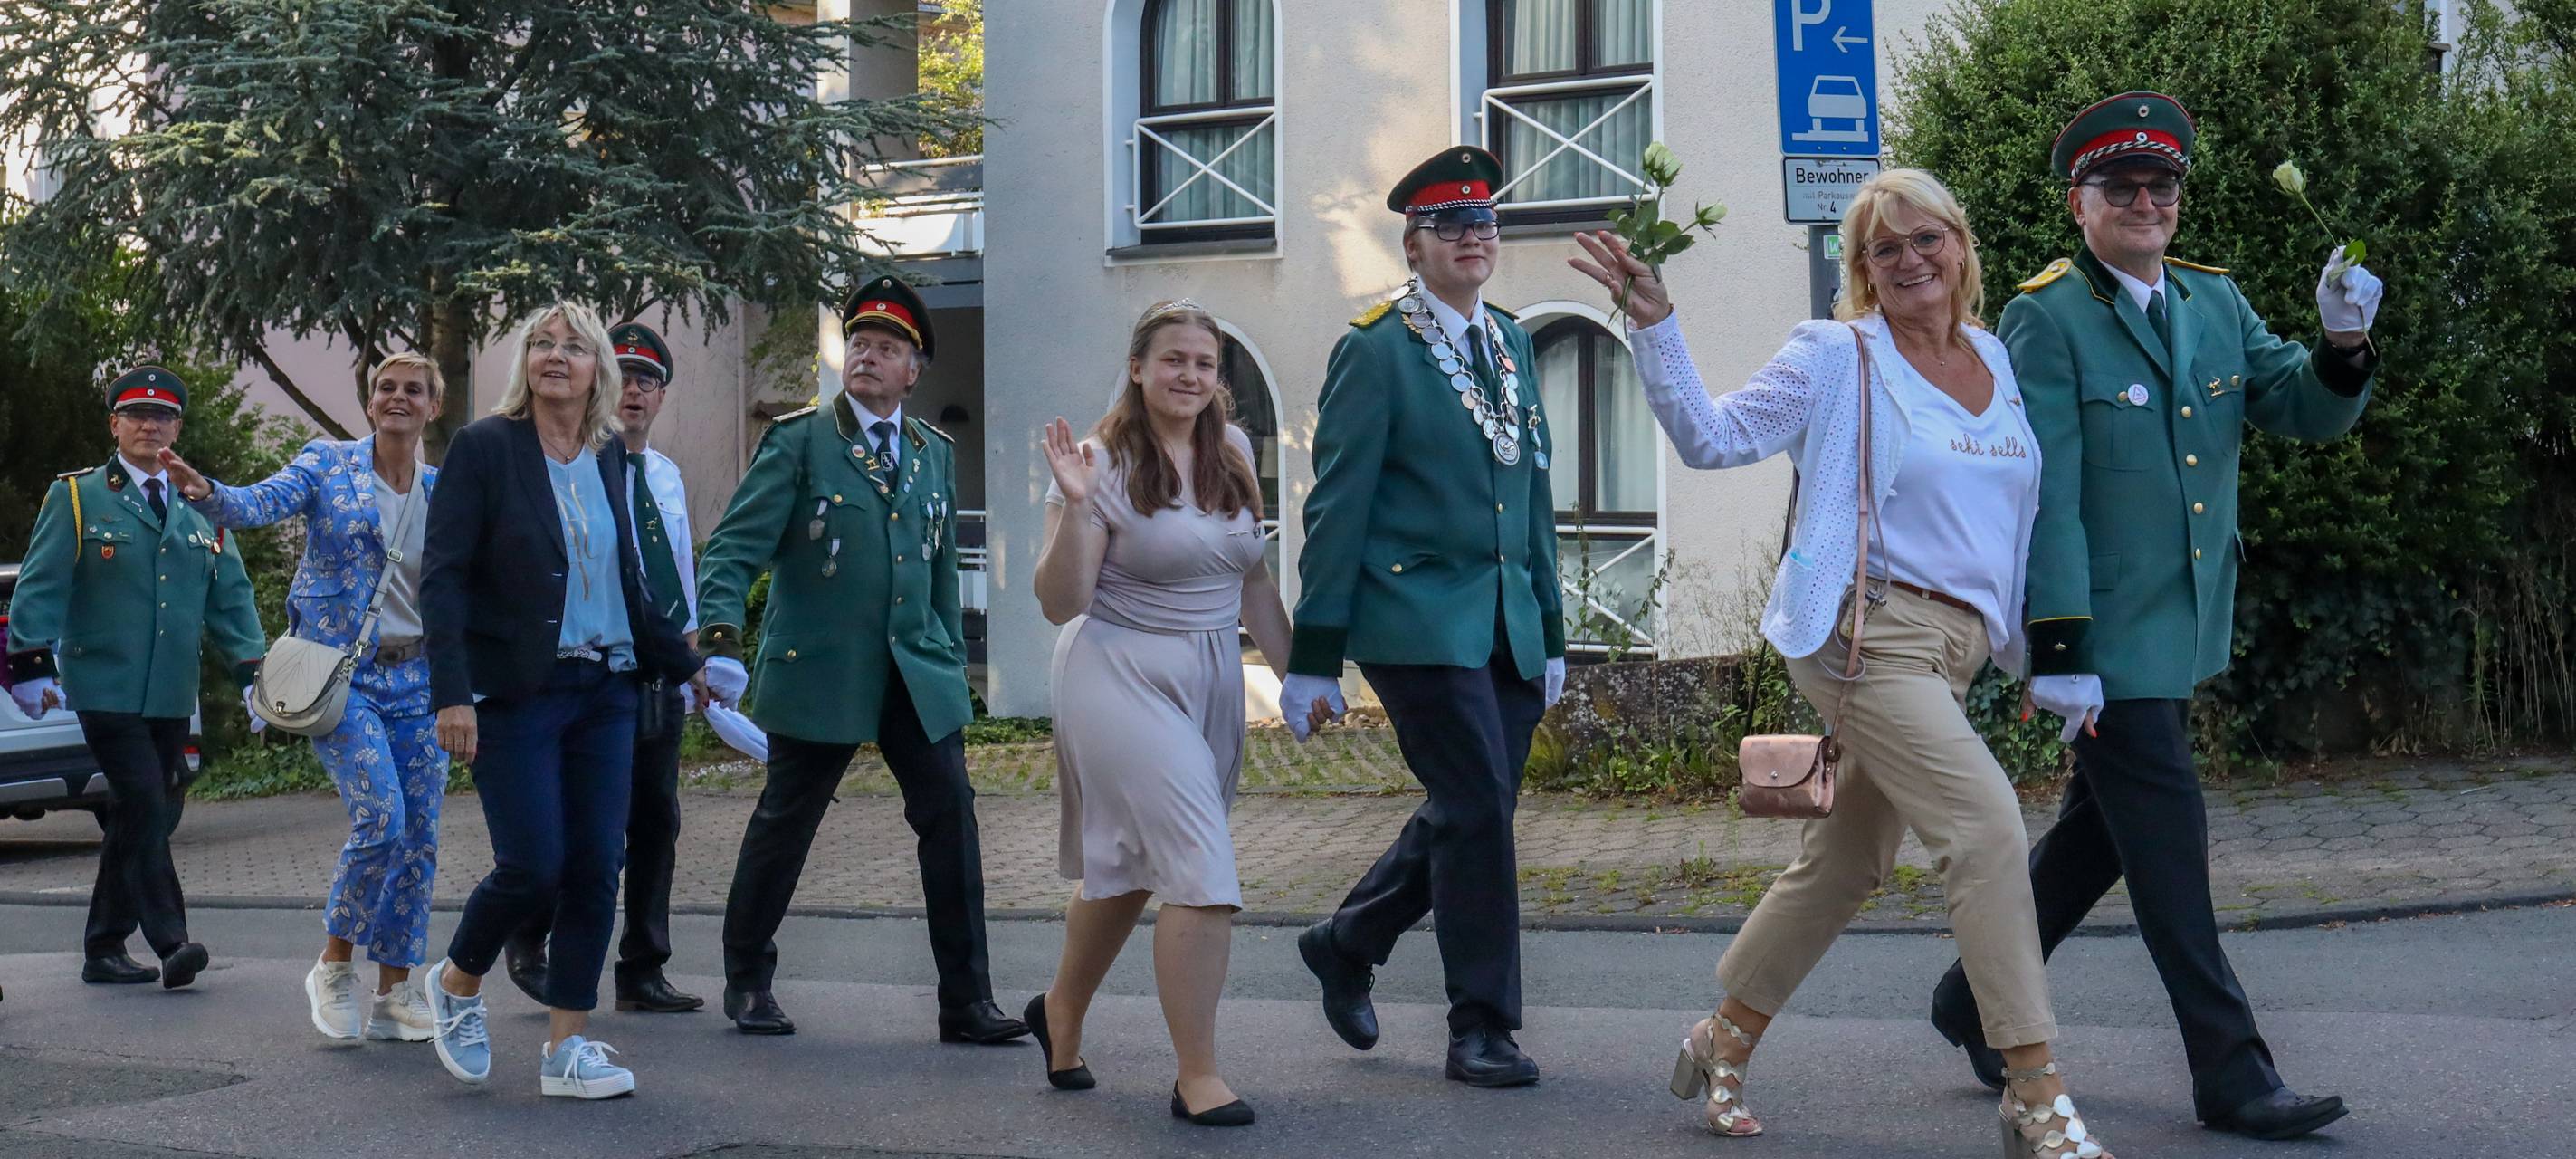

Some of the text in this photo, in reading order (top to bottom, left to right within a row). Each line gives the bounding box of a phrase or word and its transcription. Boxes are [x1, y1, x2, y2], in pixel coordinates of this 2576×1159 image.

[1791, 0, 1831, 51] P
[1796, 168, 1869, 184] Bewohner
[1829, 200, 1837, 214] 4
[1989, 436, 2027, 458] sells
